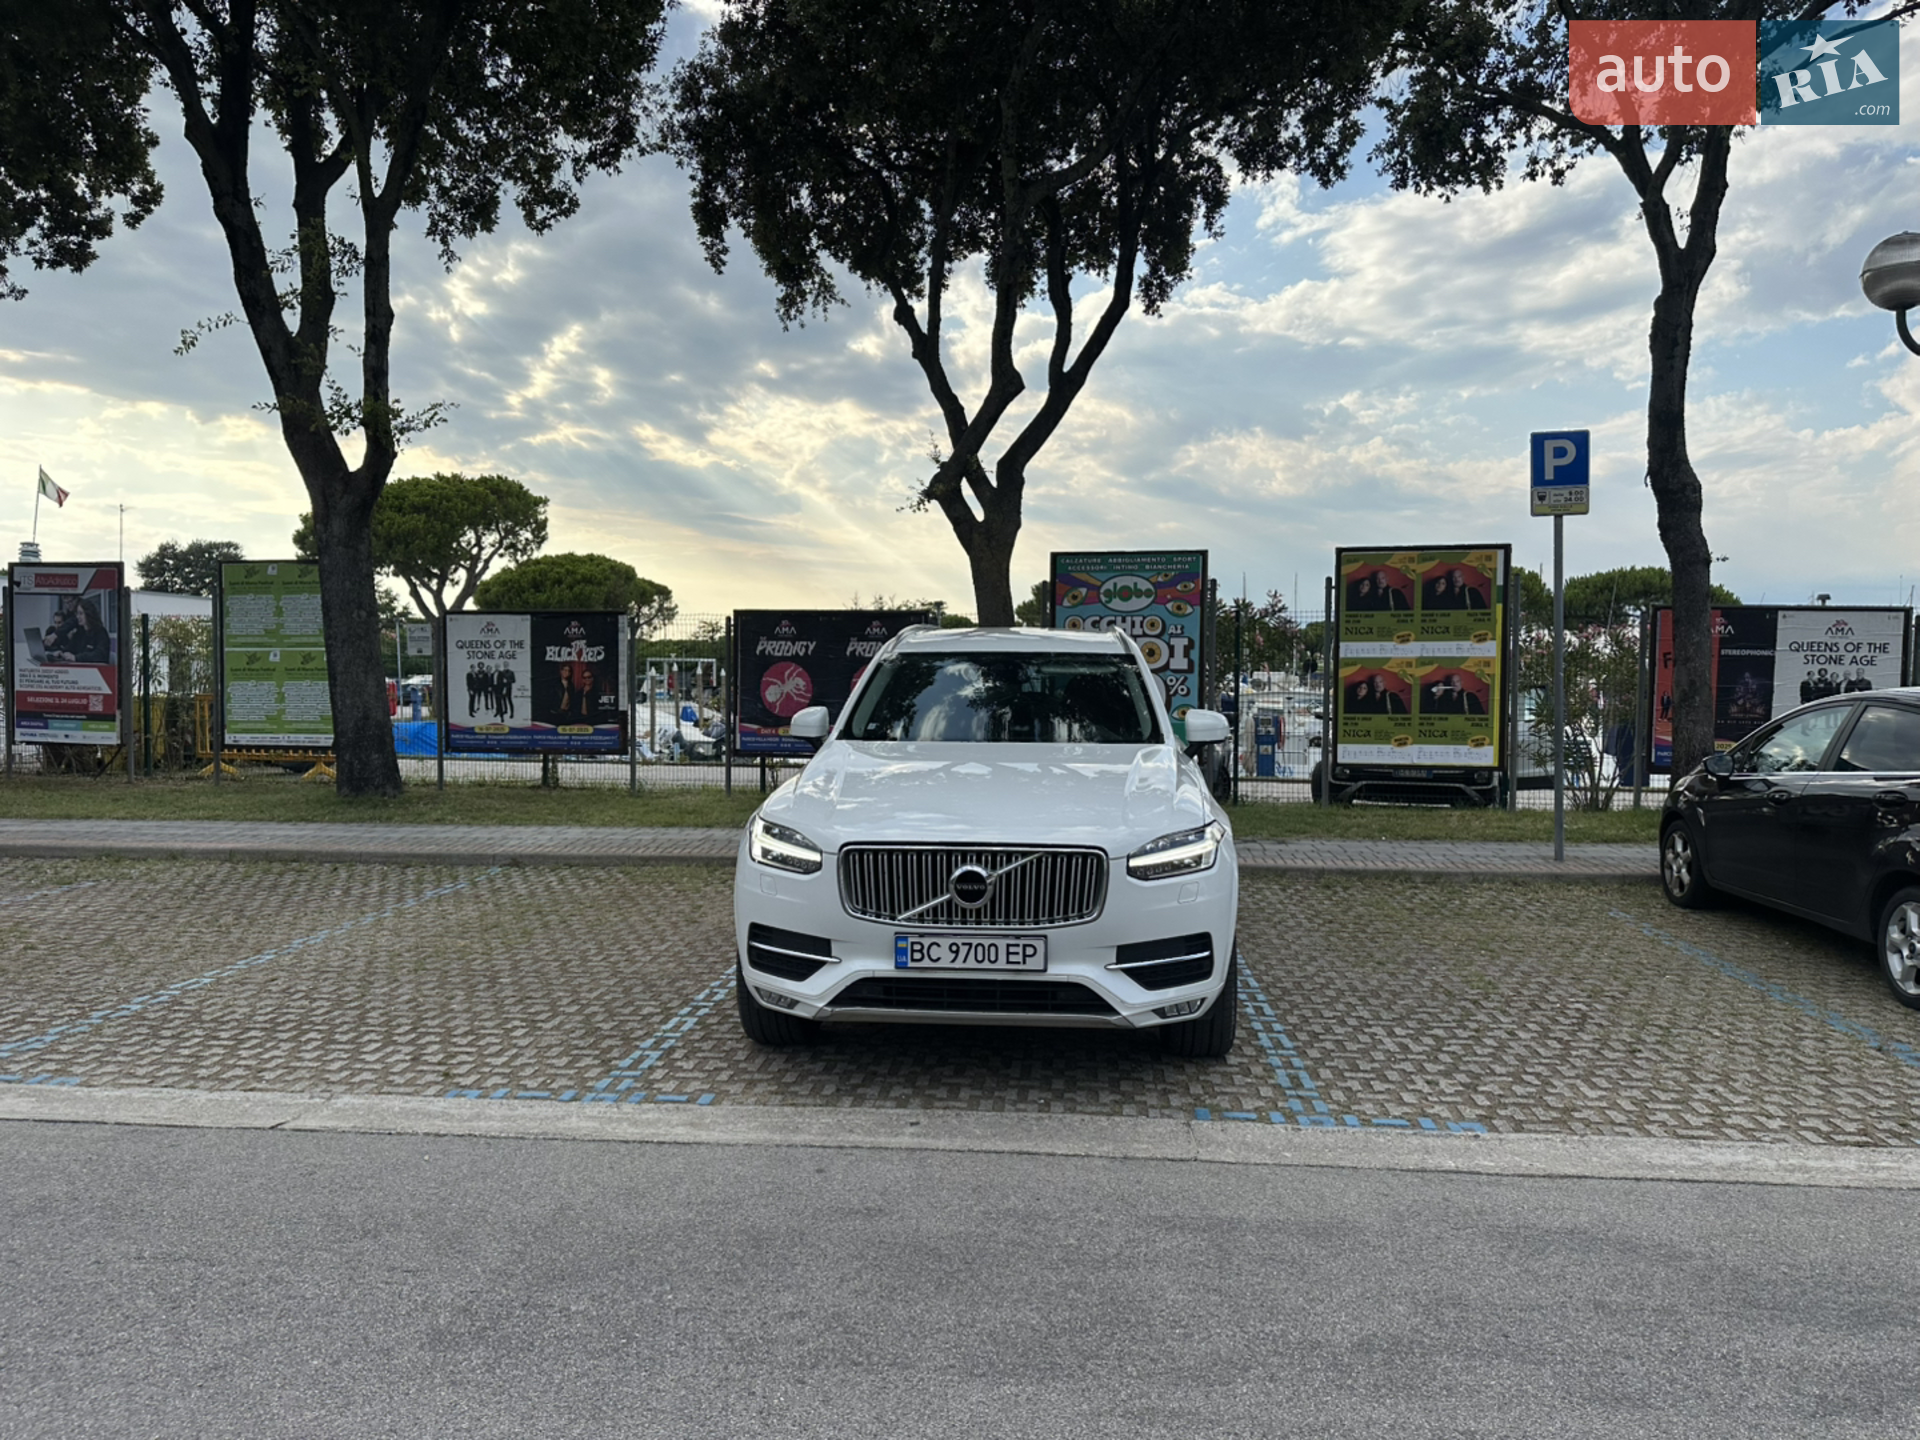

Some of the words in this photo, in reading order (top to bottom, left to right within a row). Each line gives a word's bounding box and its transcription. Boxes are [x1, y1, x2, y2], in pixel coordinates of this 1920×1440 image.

[1543, 438, 1577, 481] P
[1107, 556, 1167, 564] ABBIGLIAMENTO
[1102, 581, 1154, 604] globo
[1065, 615, 1163, 636] OCCHIO
[1168, 624, 1184, 635] AI
[456, 640, 492, 649] QUEENS
[493, 640, 507, 649] OF
[509, 640, 525, 649] THE
[756, 640, 817, 657] PRODIGY
[1788, 641, 1840, 653] QUEENS
[1843, 641, 1863, 653] OF
[1867, 642, 1890, 654] THE
[466, 651, 495, 660] STONE
[498, 651, 517, 660] AGE
[545, 646, 578, 662] BLACK
[1720, 648, 1776, 656] STEREOPHONIC
[1803, 654, 1846, 665] STONE
[1849, 655, 1878, 666] AGE
[598, 695, 616, 704] JET
[910, 941, 941, 963] BC
[948, 942, 999, 964] 9700
[1006, 943, 1038, 965] EP
